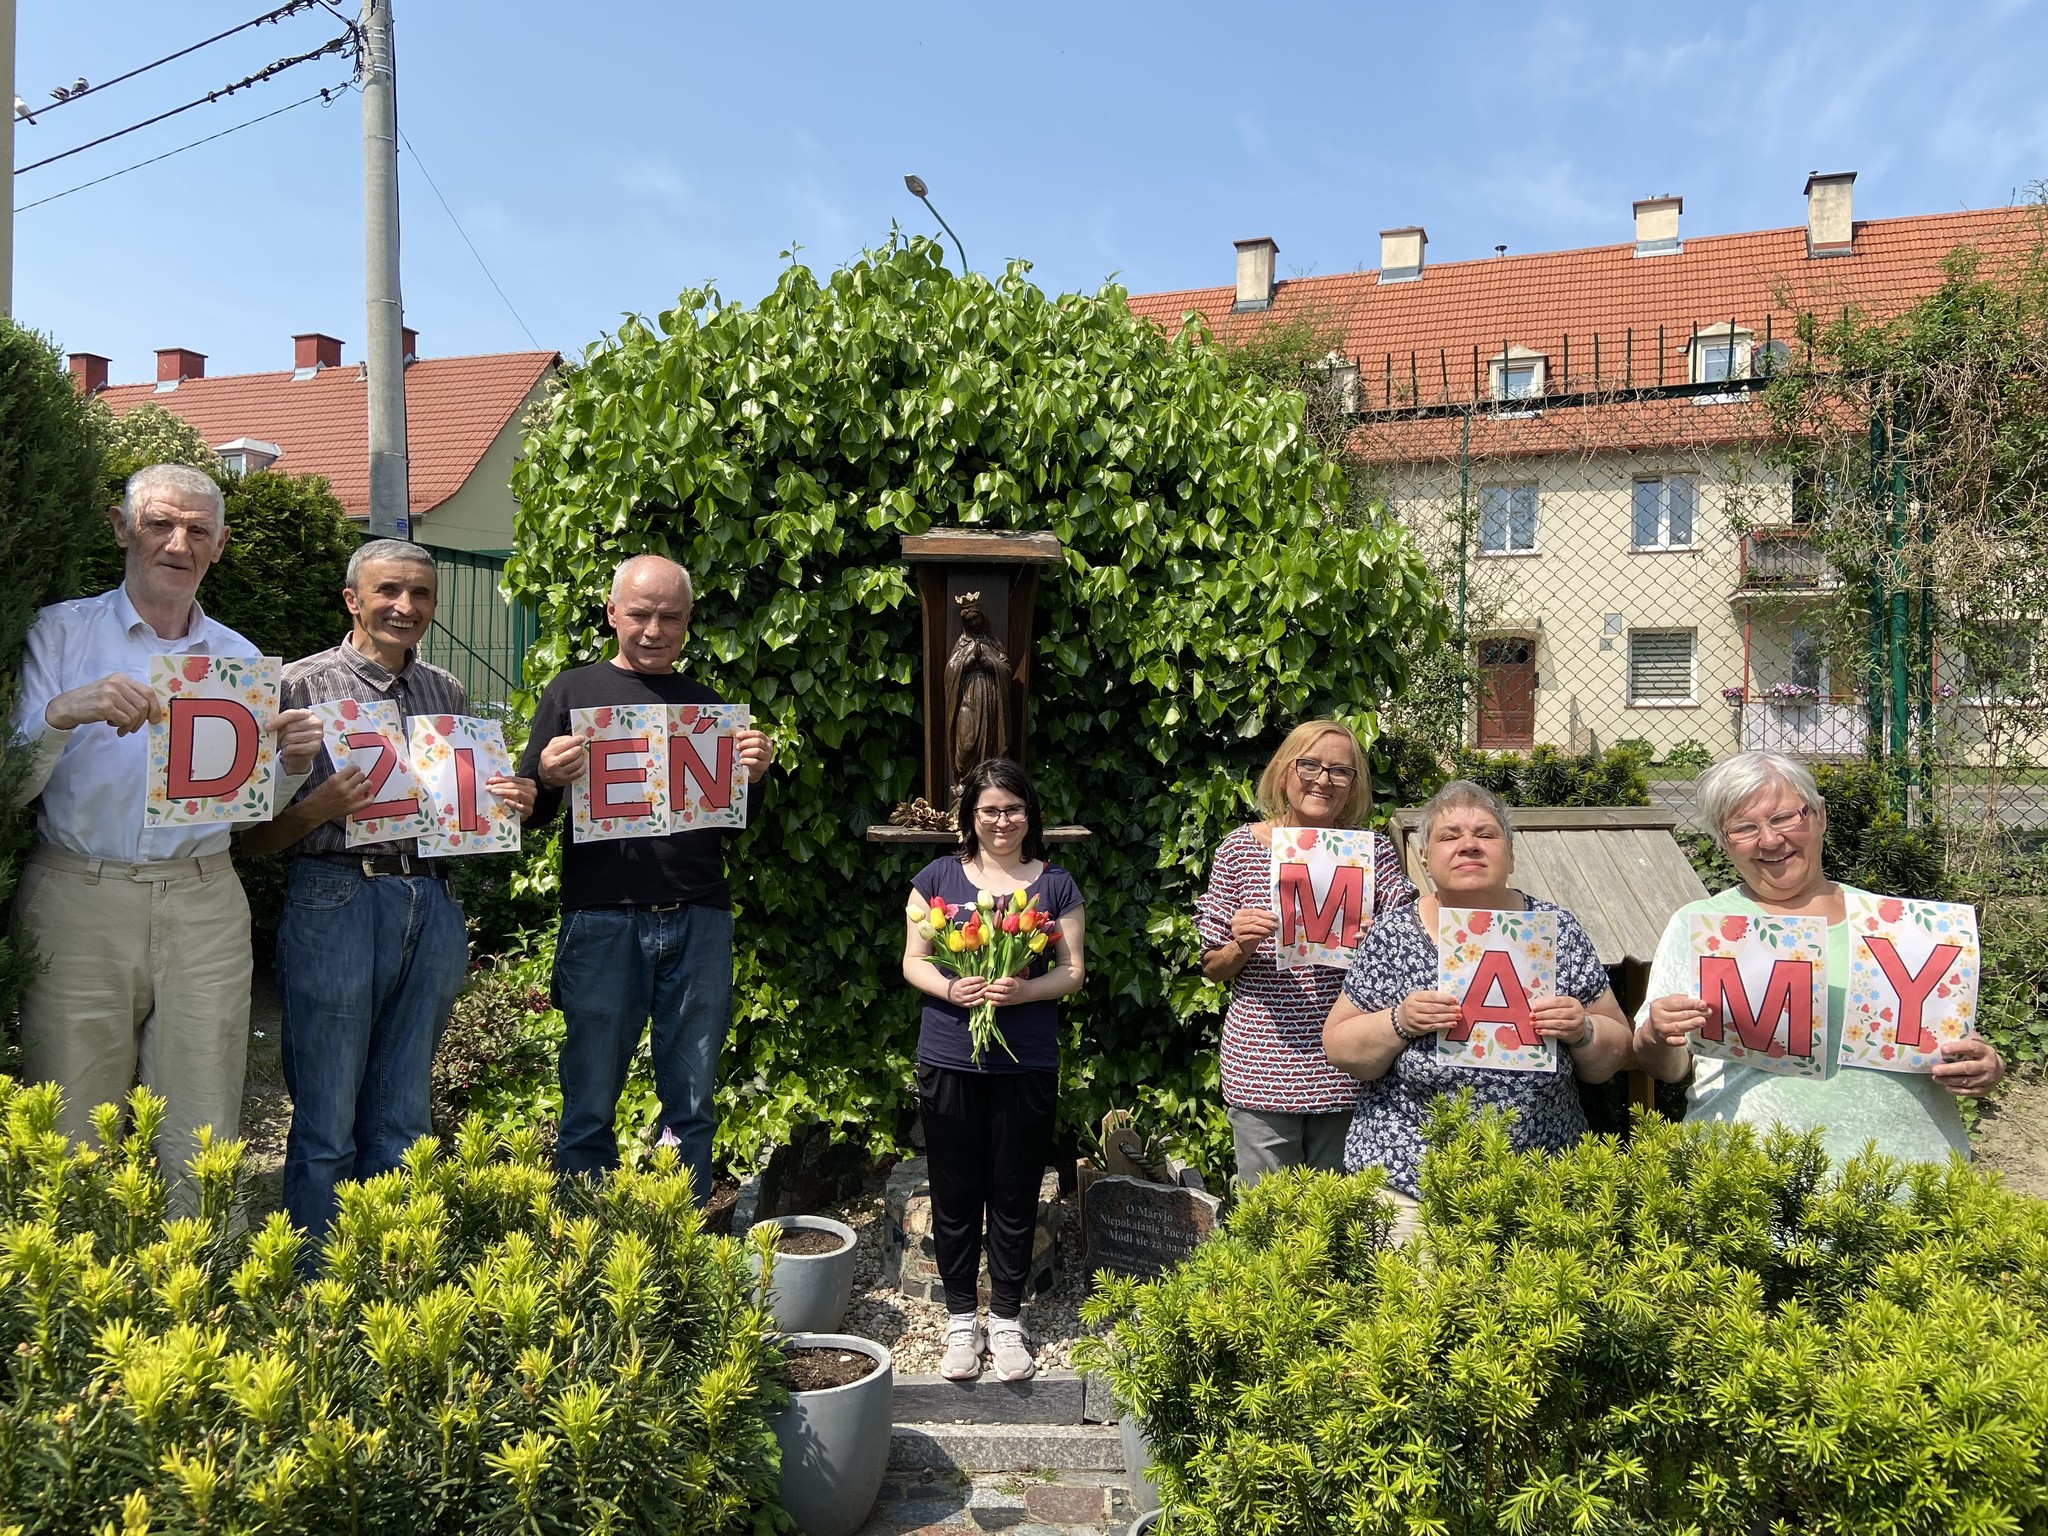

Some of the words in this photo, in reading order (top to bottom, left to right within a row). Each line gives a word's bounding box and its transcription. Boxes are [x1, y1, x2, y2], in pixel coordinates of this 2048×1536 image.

[1126, 1205, 1134, 1214] O
[1137, 1207, 1173, 1222] Maryjo
[1101, 1214, 1160, 1235] Niepokalanie
